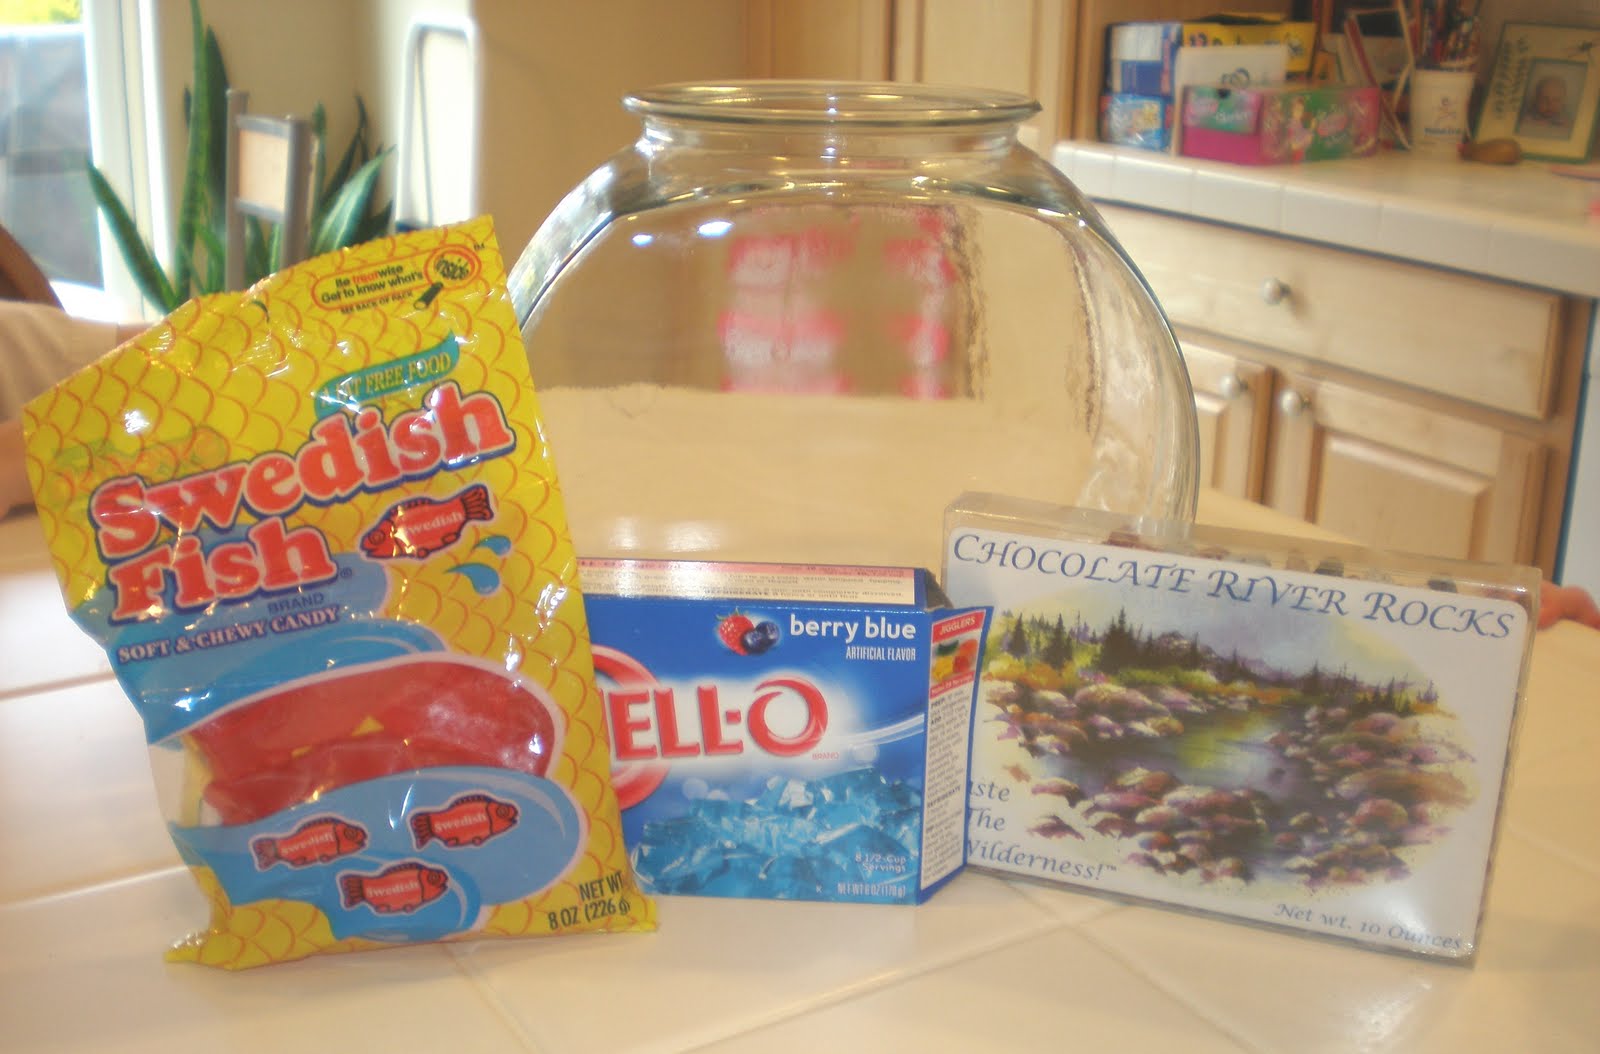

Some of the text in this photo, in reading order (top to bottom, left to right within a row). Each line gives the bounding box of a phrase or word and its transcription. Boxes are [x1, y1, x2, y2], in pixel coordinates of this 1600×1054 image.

[321, 271, 424, 304] Get to know what's
[335, 277, 350, 289] Be
[356, 300, 379, 312] BACK
[379, 296, 391, 307] OF
[391, 290, 414, 303] PACK
[365, 365, 403, 394] FREE
[408, 352, 451, 381] FOOD
[89, 380, 517, 559] Swedish
[402, 510, 464, 537] wedish
[108, 516, 339, 626] Fish
[953, 533, 1515, 639] CHOCOLATE RIVER ROCKS
[267, 592, 325, 614] BRAND
[117, 606, 341, 664] SOFT & CHEWY CANDY
[790, 612, 917, 644] berry blue
[939, 616, 976, 636] JIGGLERS
[845, 646, 917, 662] ARTIFICIAL FLAVOR
[600, 677, 829, 761] ELL-O
[968, 780, 1010, 802] ste
[862, 862, 907, 874] Servings
[579, 879, 605, 902] NET
[548, 911, 559, 930] 8
[560, 905, 578, 928] OZ
[584, 898, 617, 922] (226
[1273, 903, 1463, 950] Net wt. 10 Ounces
